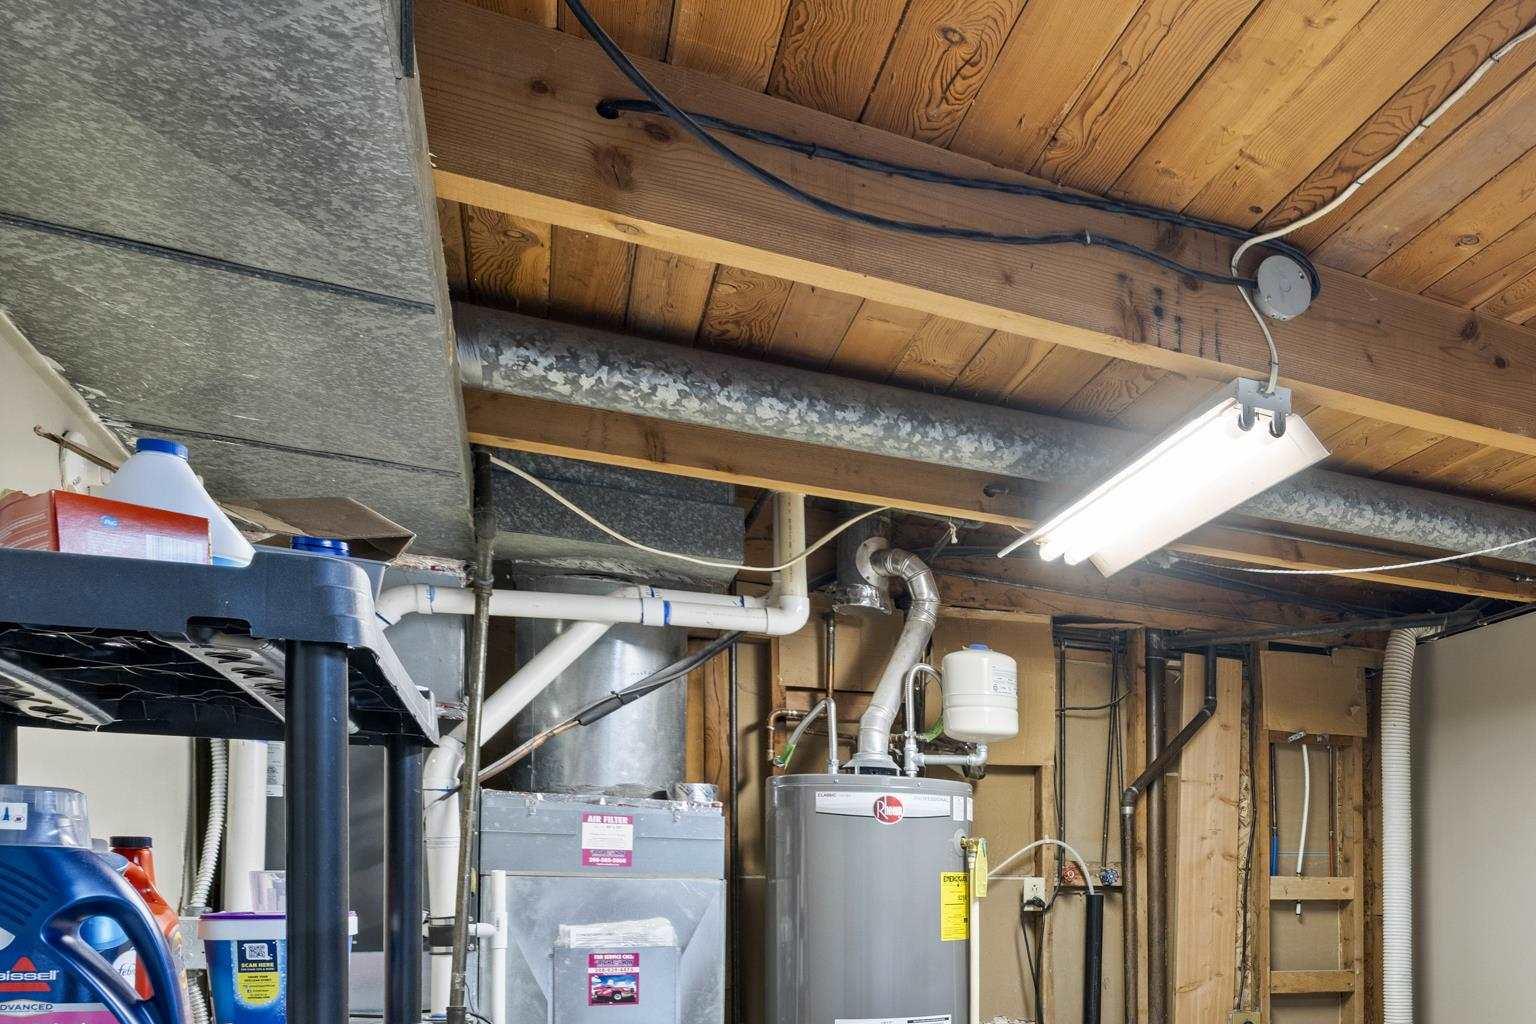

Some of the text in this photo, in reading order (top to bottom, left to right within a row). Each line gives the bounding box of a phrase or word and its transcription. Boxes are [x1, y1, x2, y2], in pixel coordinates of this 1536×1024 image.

[587, 815, 628, 824] AIR FILTER
[0, 1003, 53, 1011] DVANCED
